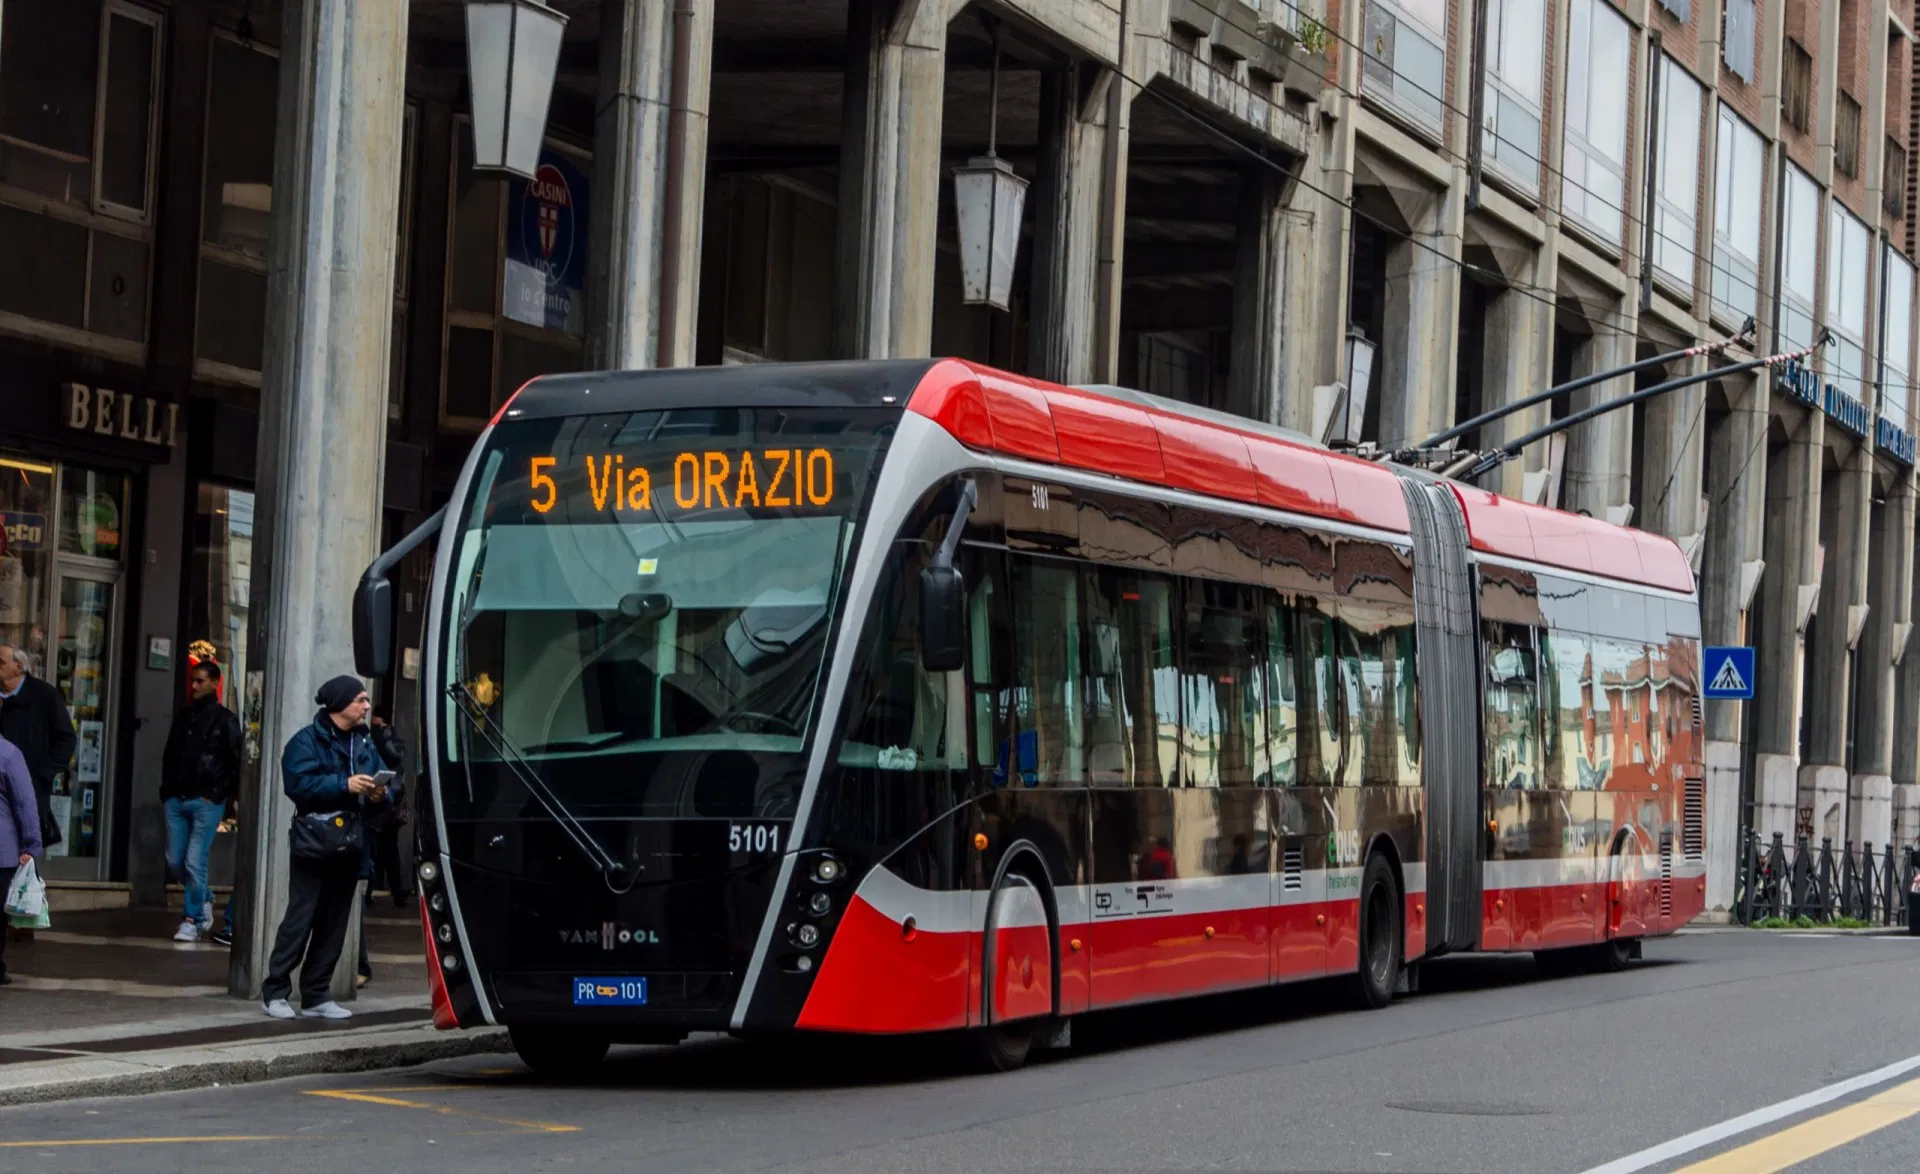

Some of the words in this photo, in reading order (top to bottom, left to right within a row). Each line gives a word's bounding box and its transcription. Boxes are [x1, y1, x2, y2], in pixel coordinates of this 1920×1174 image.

[531, 181, 567, 205] CASINI
[68, 382, 180, 447] BELLI
[531, 456, 556, 512] 5
[587, 454, 651, 512] Via
[674, 448, 833, 508] ORAZIO
[1032, 484, 1049, 510] 5101
[729, 825, 779, 852] 5101
[578, 982, 595, 1000] PR
[621, 982, 642, 999] 101
